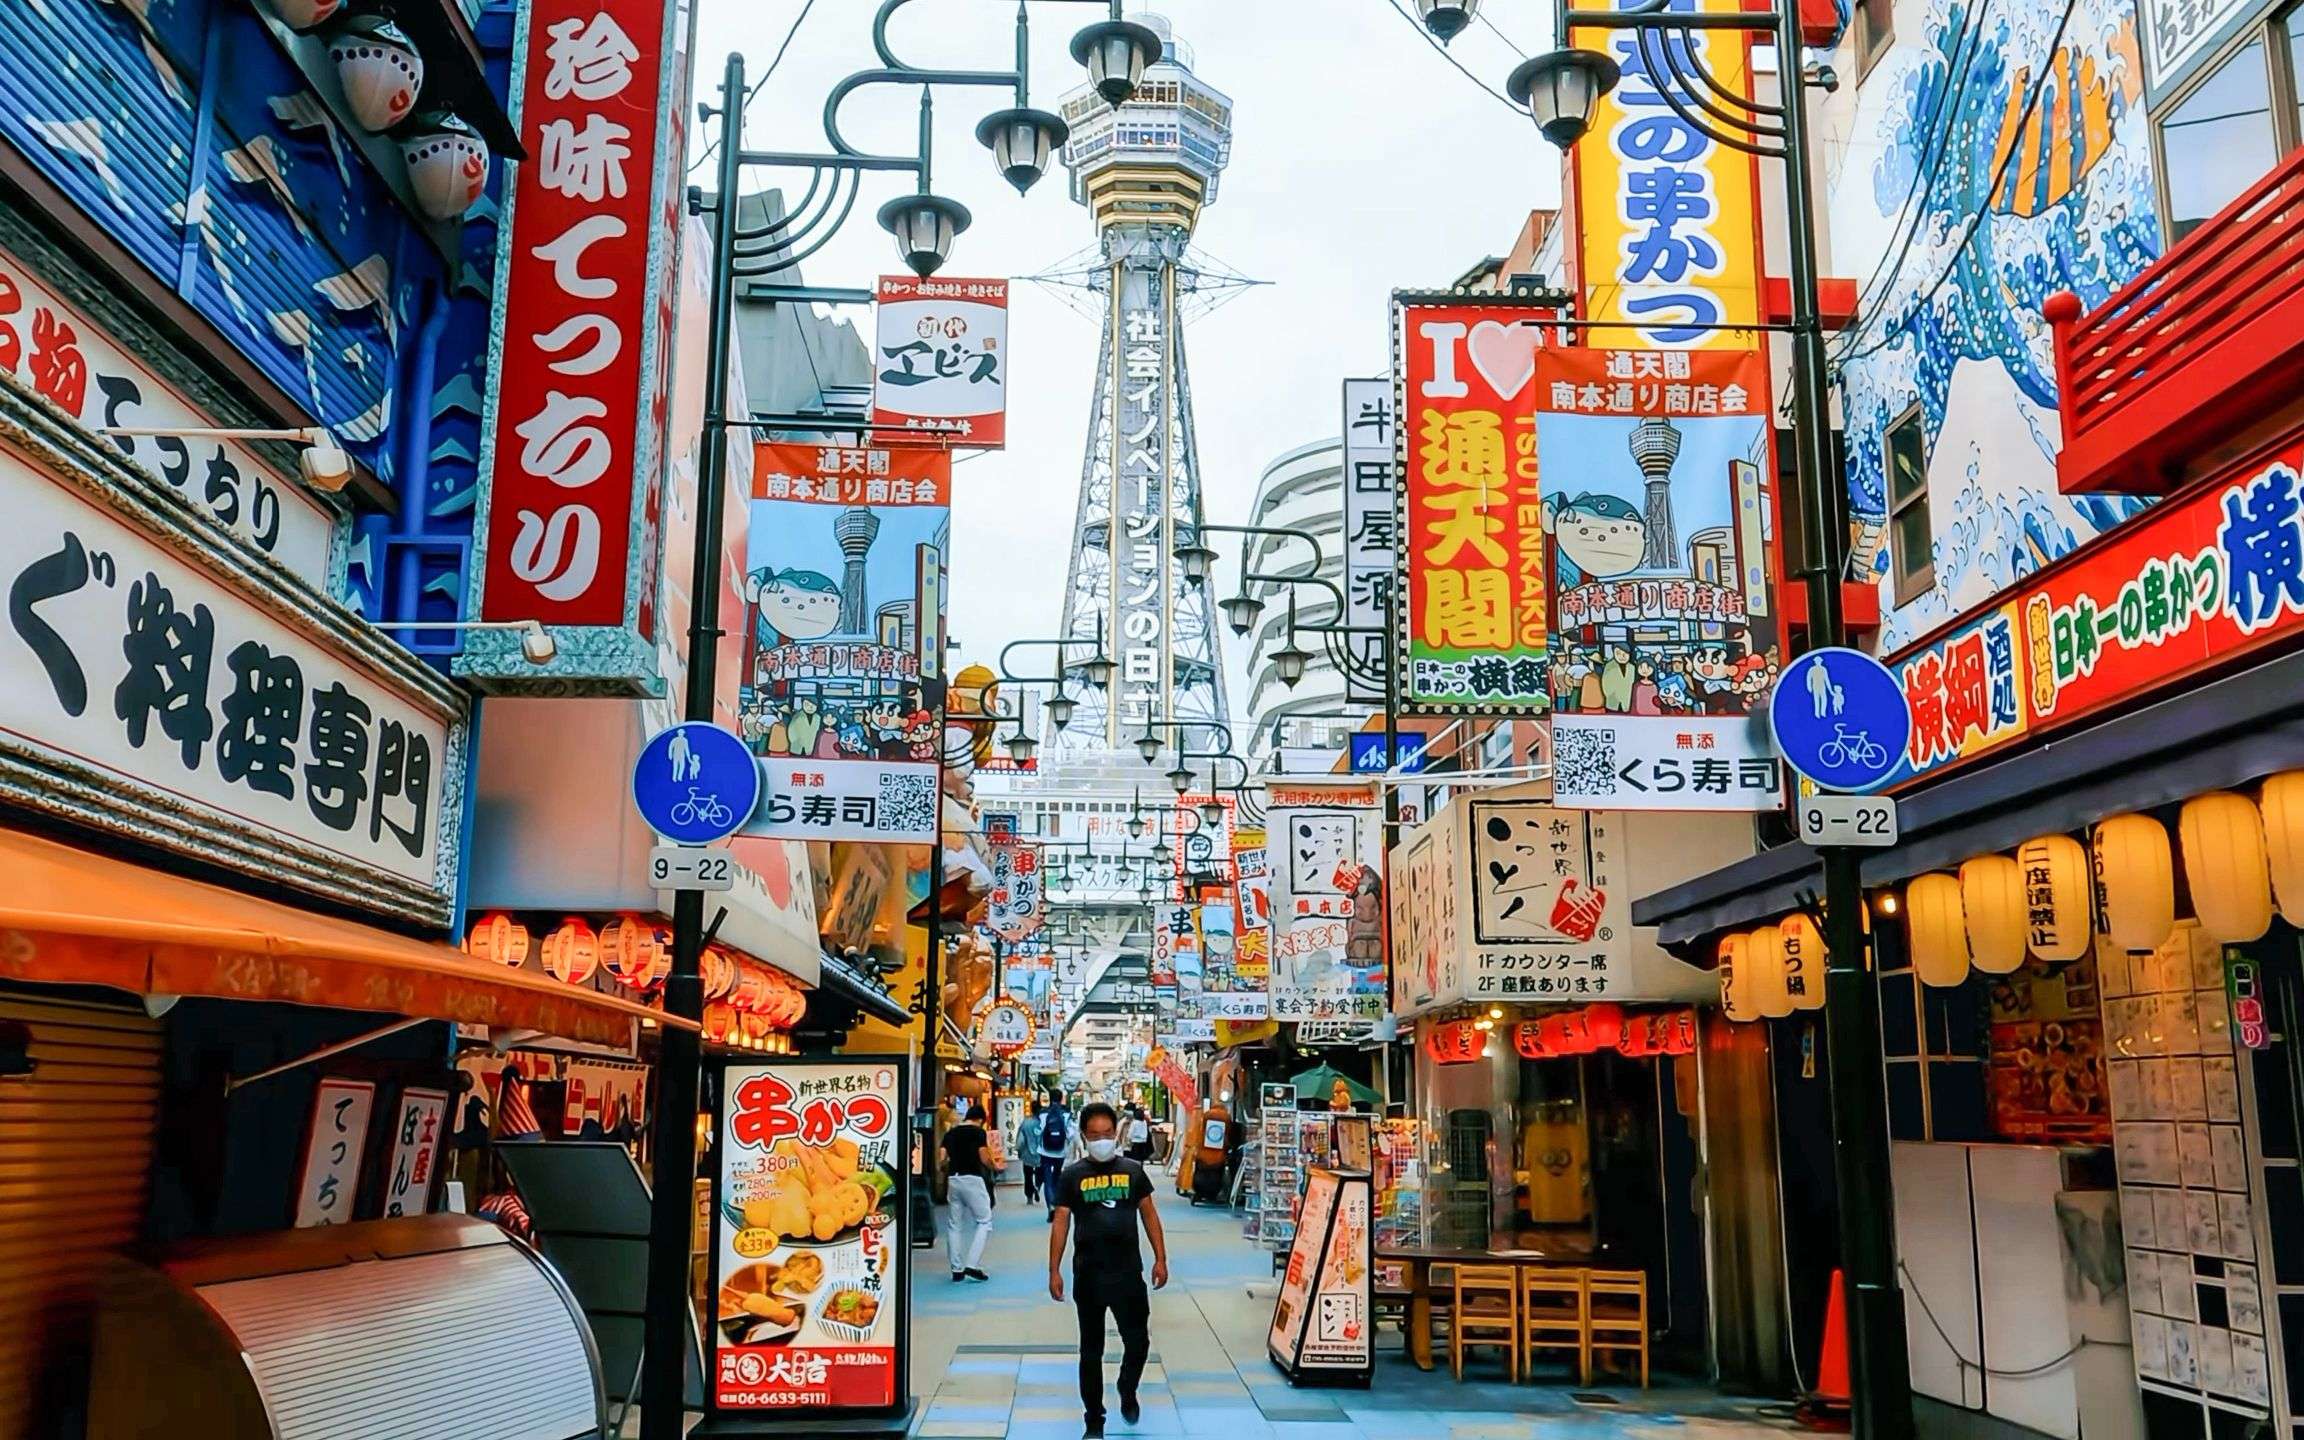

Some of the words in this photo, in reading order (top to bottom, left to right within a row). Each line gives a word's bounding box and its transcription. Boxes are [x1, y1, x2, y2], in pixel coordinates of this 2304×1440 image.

[510, 12, 640, 602] 珍味てっちり
[1605, 351, 1691, 381] 通天閣
[1551, 381, 1748, 414] 南本通り商店会
[816, 448, 891, 476] 通天閣
[767, 472, 938, 504] 南本通り商店会
[1123, 310, 1162, 725] 社会イノベーションの日立
[1419, 408, 1514, 649] 通天閣
[1561, 580, 1746, 620] 南本通り商店街
[2053, 554, 2220, 681] 日本一の串かつ
[758, 644, 920, 678] 南本通り商店街
[1676, 732, 1716, 749] 無添
[790, 771, 825, 788] 無添
[1618, 758, 1780, 795] くら寿司
[1478, 954, 1495, 970] 1F
[1501, 953, 1608, 971] カウンター席
[1478, 976, 1496, 992] 2F
[1501, 976, 1609, 993] 座敷あります
[732, 1075, 889, 1150] 串かつ
